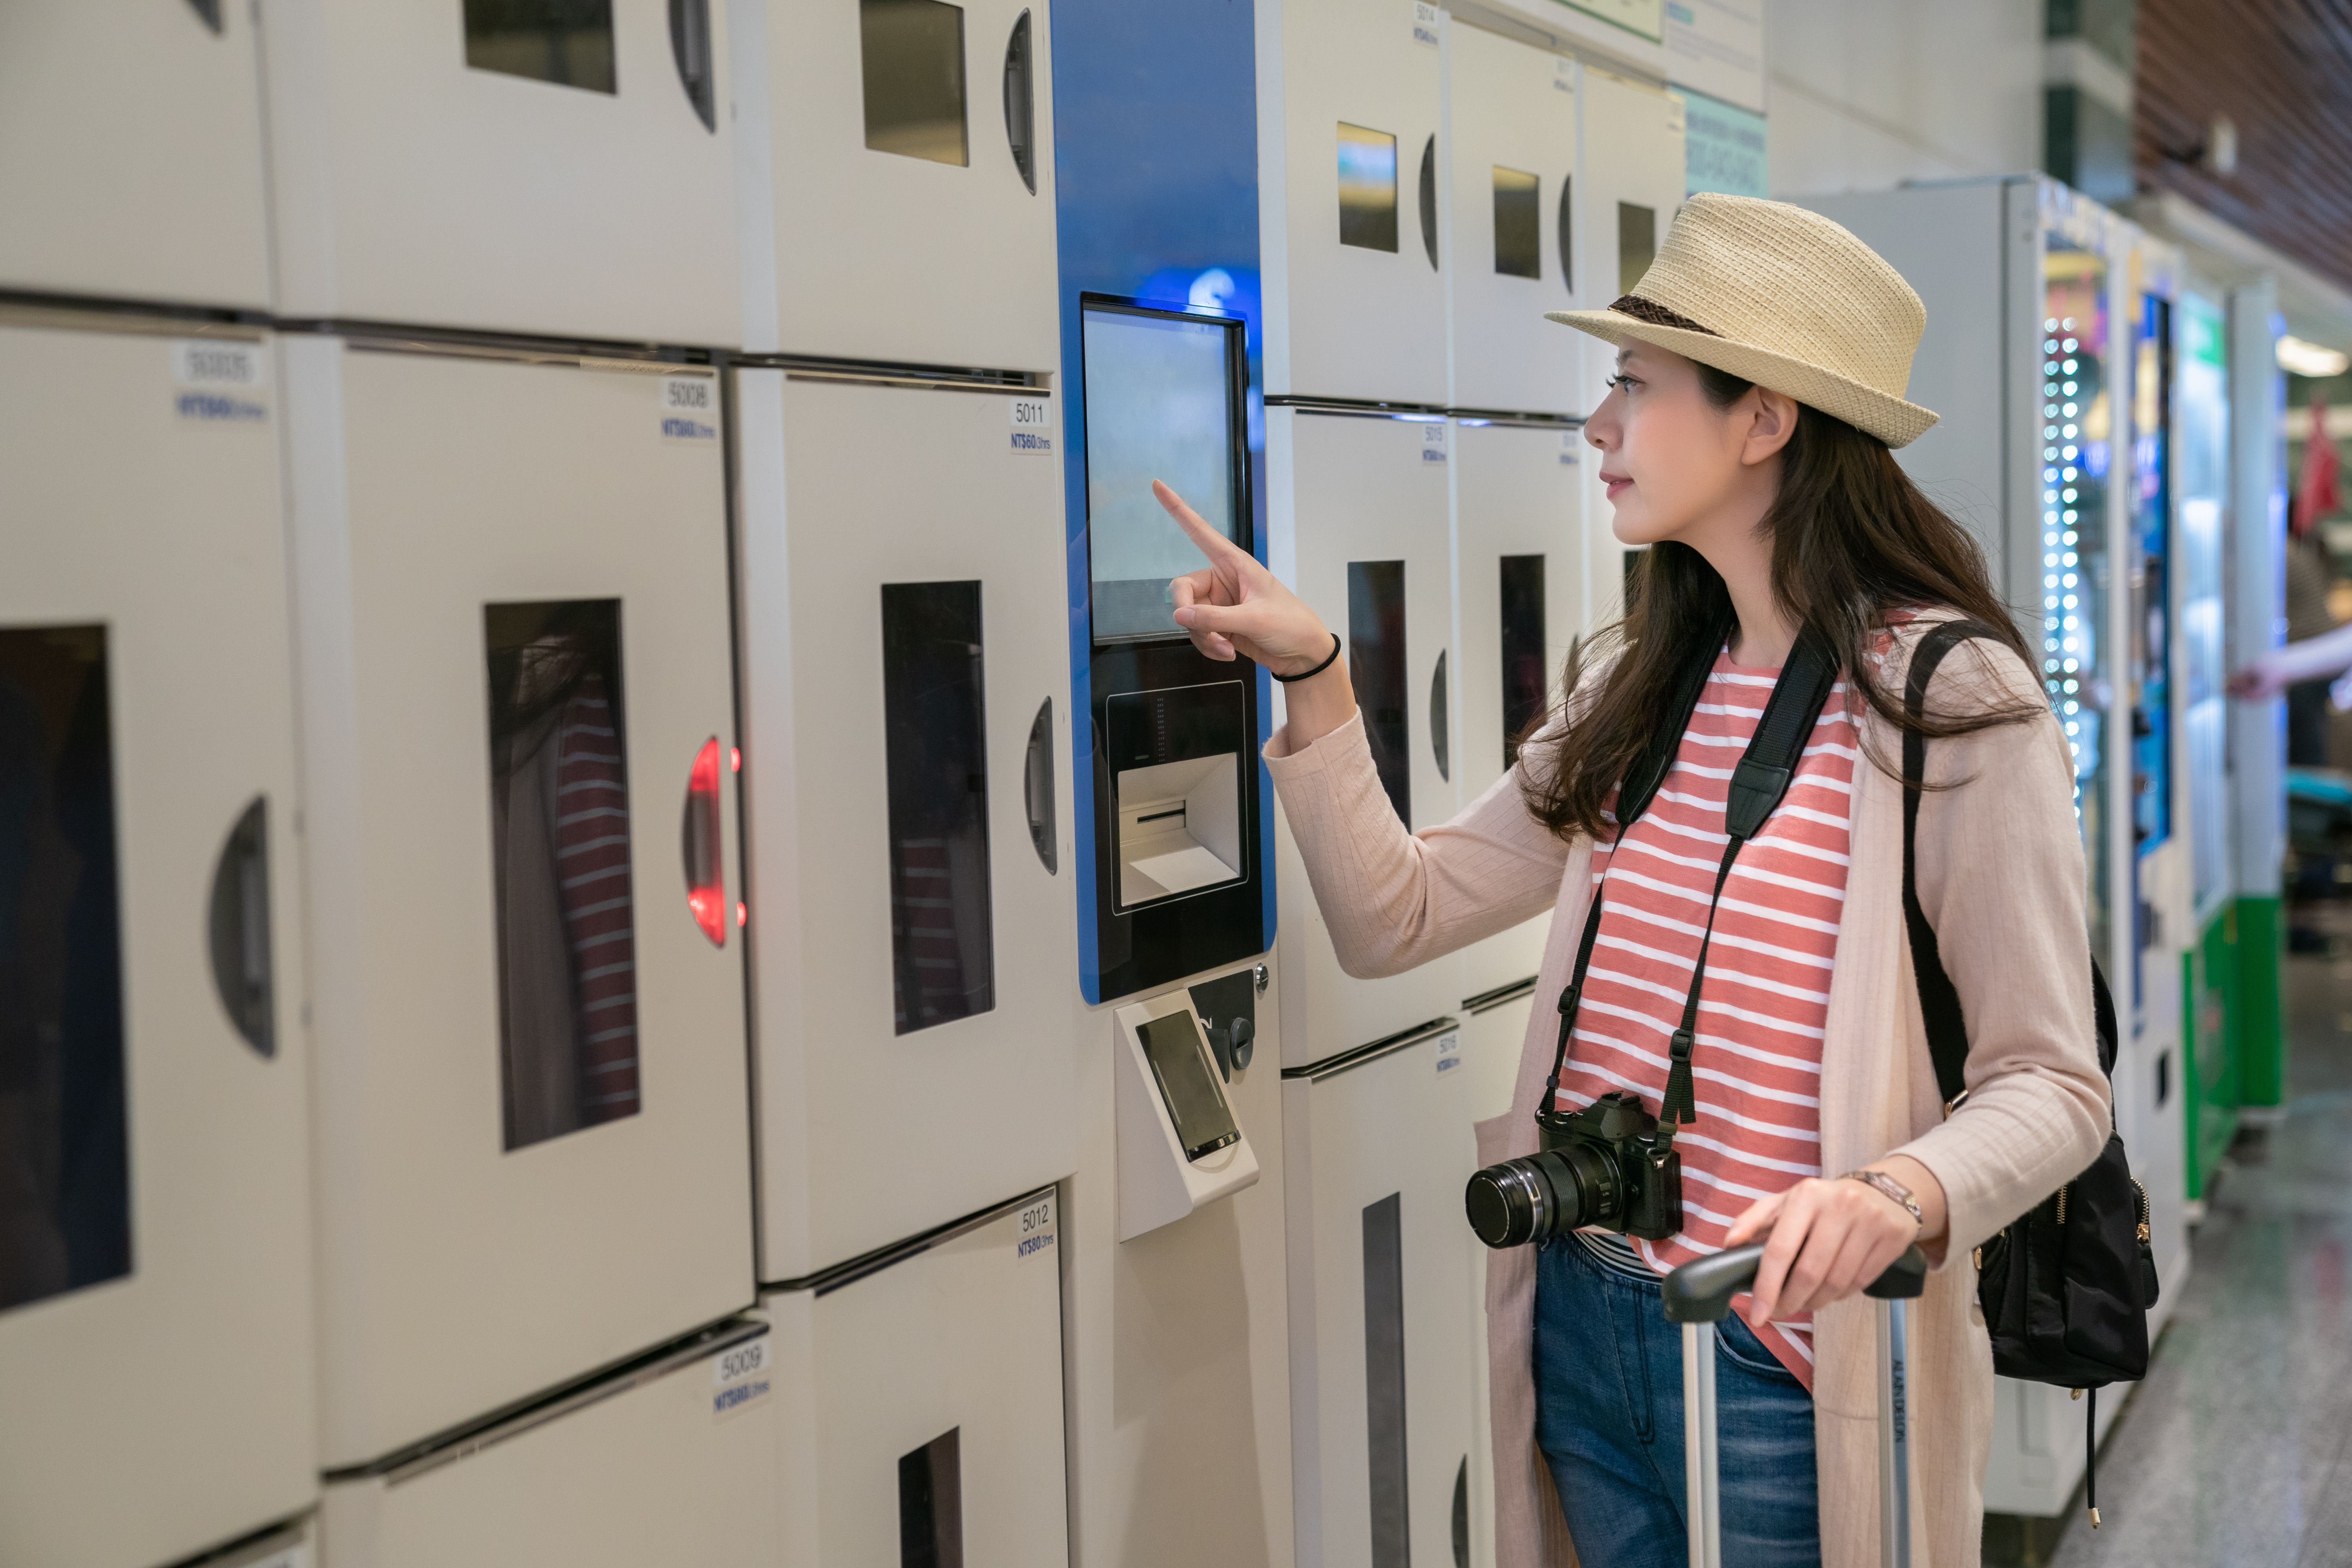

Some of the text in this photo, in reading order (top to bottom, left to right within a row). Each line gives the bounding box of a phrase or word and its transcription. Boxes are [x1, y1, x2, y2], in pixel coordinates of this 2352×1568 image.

[1016, 403, 1042, 423] 5011
[1023, 1204, 1048, 1232] 5012
[721, 1342, 763, 1380] 5009
